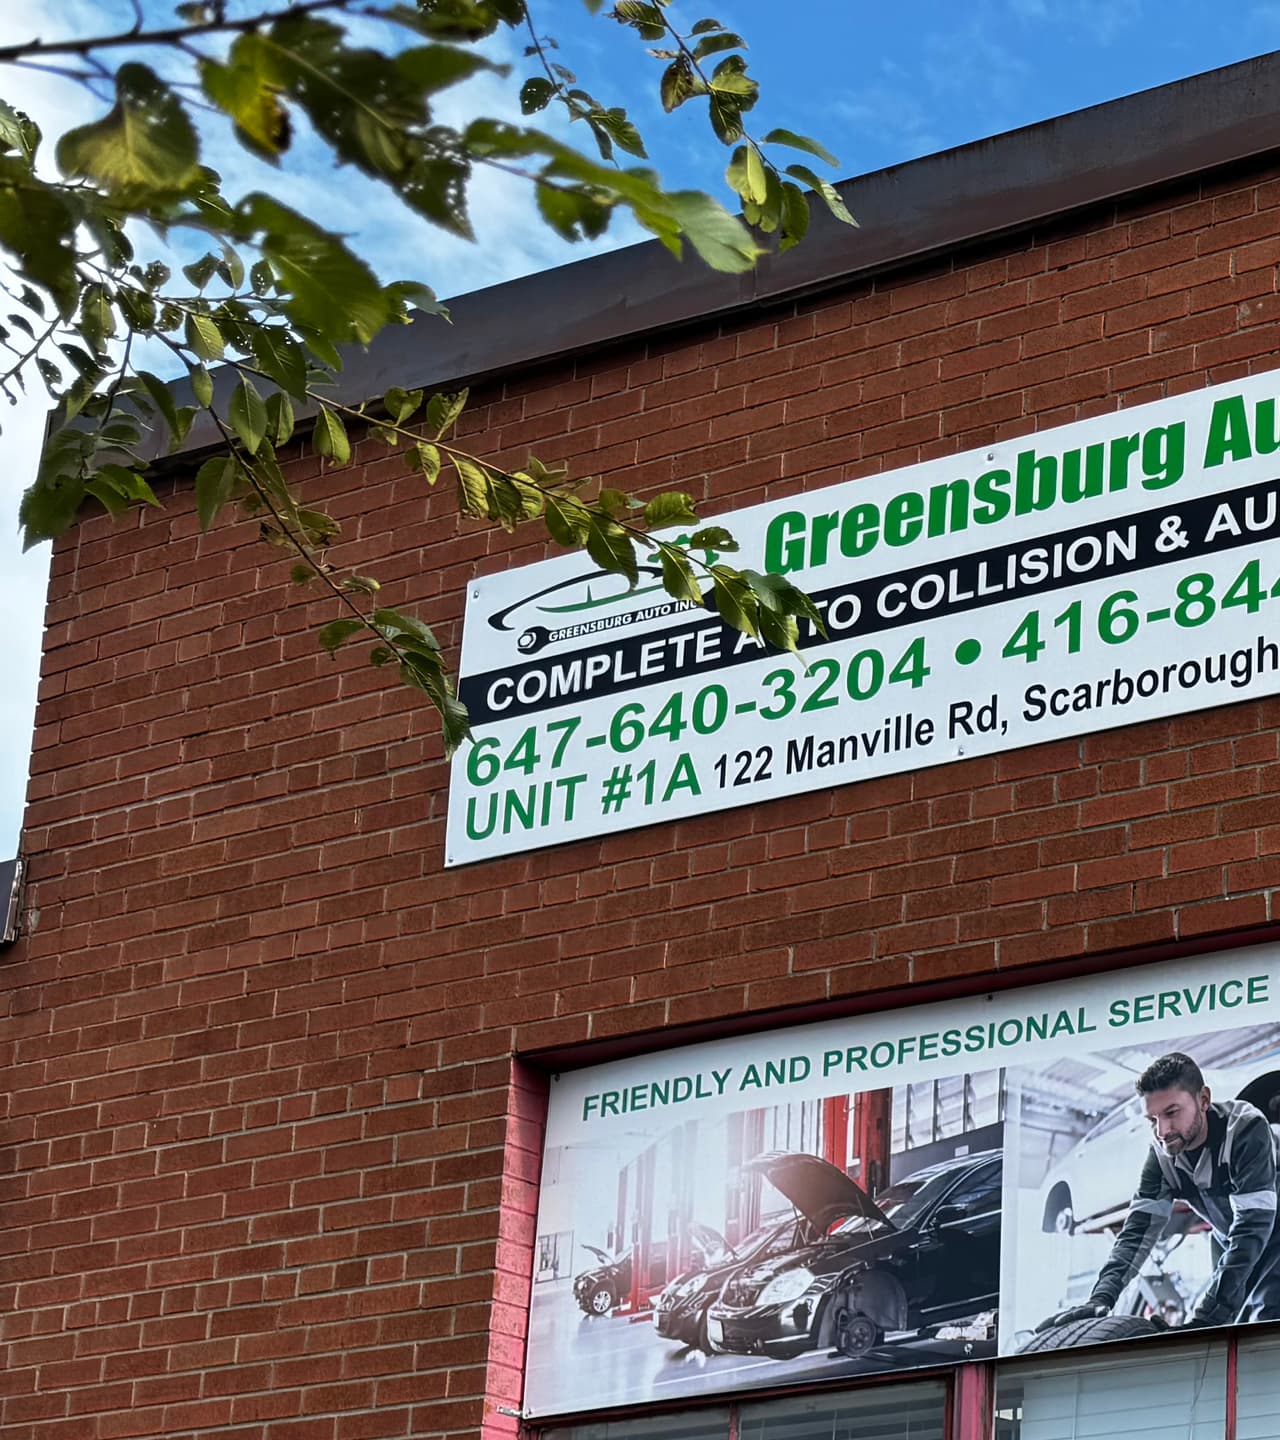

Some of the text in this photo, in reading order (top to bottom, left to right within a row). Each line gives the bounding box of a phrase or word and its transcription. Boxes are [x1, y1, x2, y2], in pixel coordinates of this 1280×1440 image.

[764, 421, 1186, 576] Greensburg
[487, 626, 722, 711] COMPLETE
[876, 525, 1137, 624] COLLISION
[1155, 515, 1190, 553] &
[549, 614, 632, 643] GREENSBURG
[635, 604, 671, 622] AUTO
[466, 636, 931, 788] 647-640-3204
[466, 776, 587, 841] UNIT
[601, 753, 702, 815] #1A
[714, 747, 773, 790] 122
[787, 714, 934, 775] Manville
[948, 694, 1009, 739] Rd,
[1023, 639, 1279, 724] Scarborough
[582, 975, 1270, 1122] FRIENDLY AND PROFESSIONAL SERVICE
